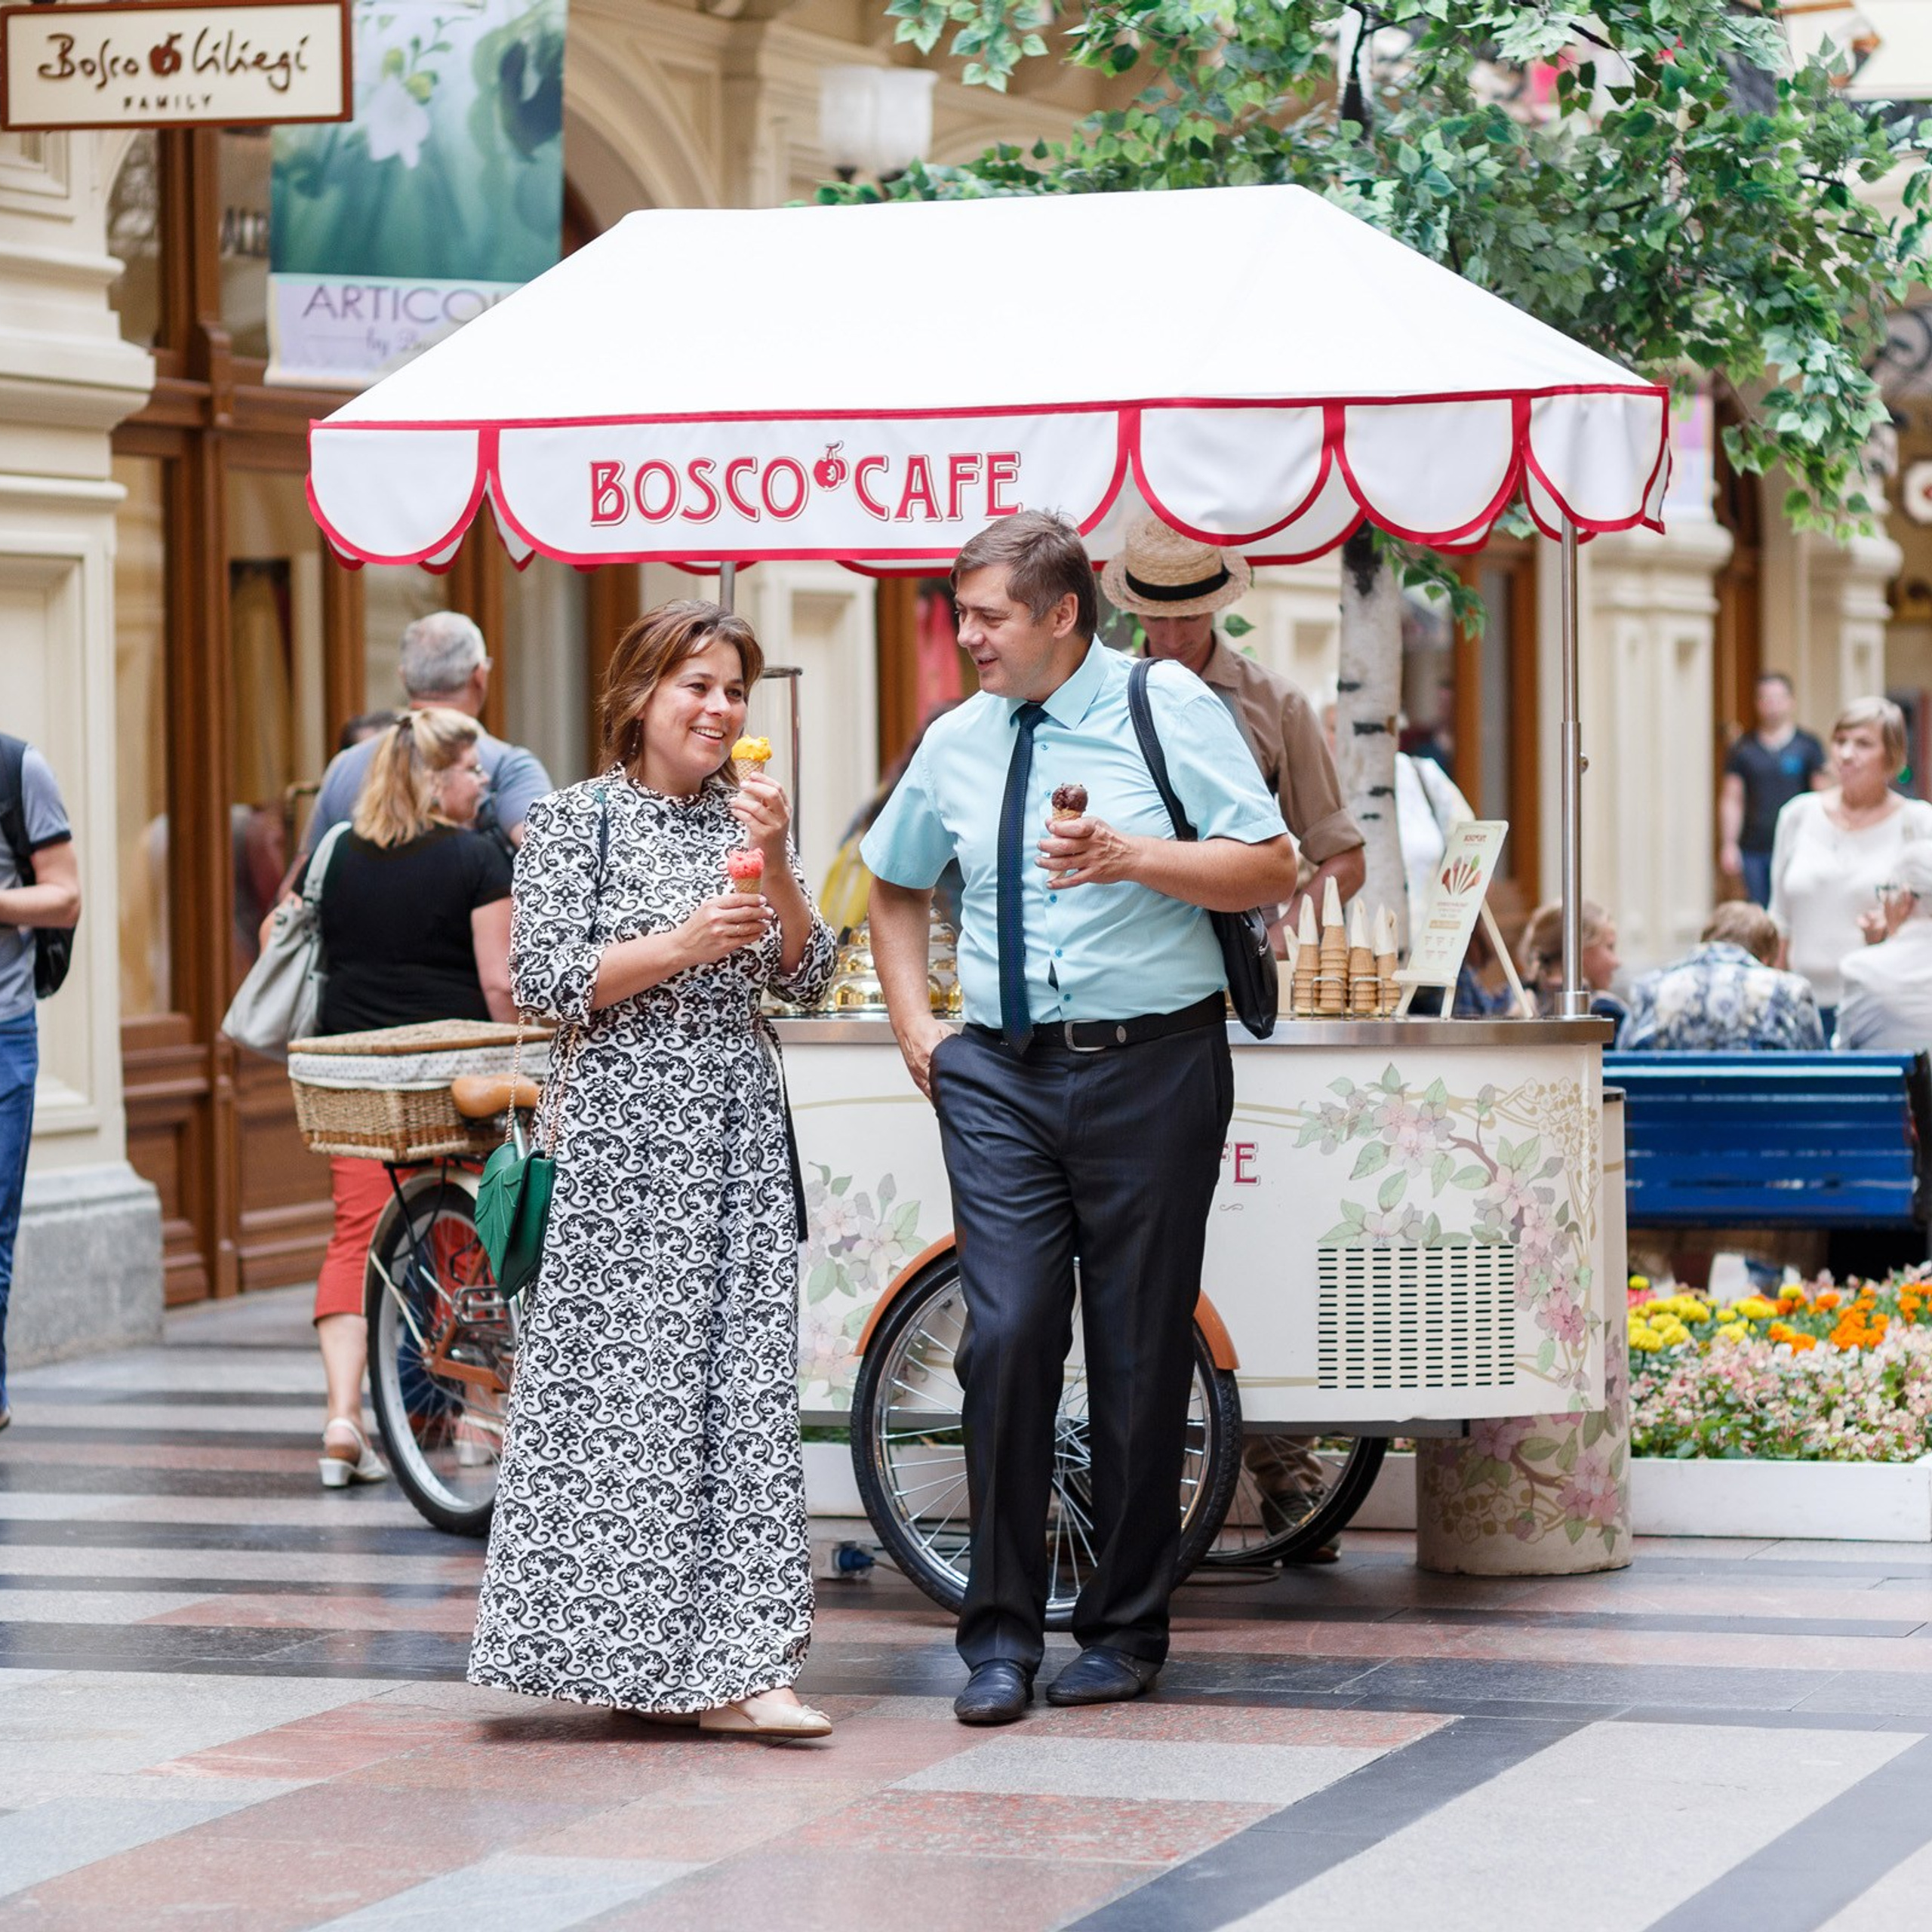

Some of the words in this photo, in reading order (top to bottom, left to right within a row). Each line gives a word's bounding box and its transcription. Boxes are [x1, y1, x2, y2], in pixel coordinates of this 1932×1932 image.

[37, 32, 140, 91] Bosco
[124, 94, 213, 112] FAMILY
[590, 456, 810, 527] BOSCO
[854, 451, 1023, 522] CAFE
